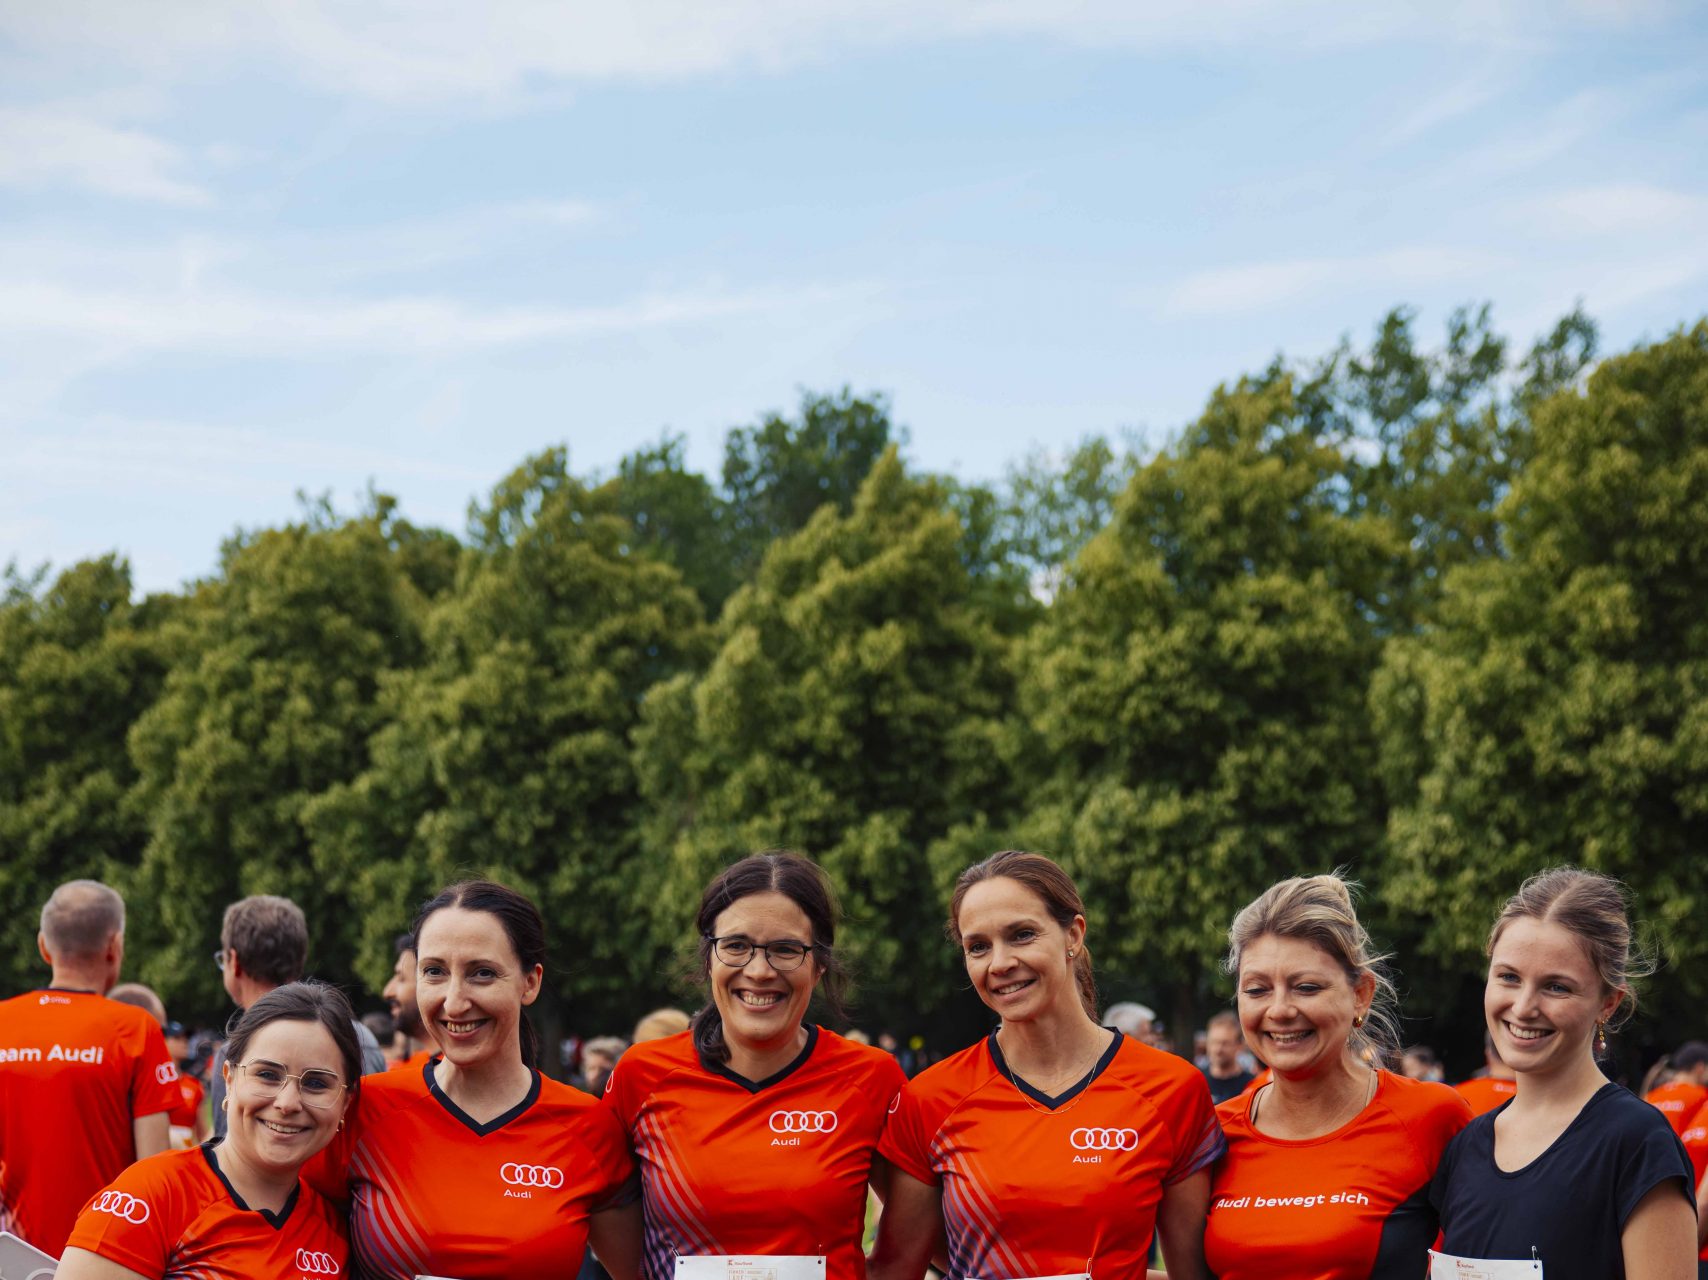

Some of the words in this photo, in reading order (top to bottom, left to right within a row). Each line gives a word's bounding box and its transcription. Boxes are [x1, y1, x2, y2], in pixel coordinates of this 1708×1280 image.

[47, 1044, 104, 1064] Audi
[771, 1138, 800, 1146] Audi
[1073, 1155, 1102, 1163] Audi
[504, 1189, 532, 1198] Audi
[1216, 1197, 1250, 1209] Audi
[1254, 1194, 1325, 1208] bewegt
[1330, 1192, 1369, 1206] sich
